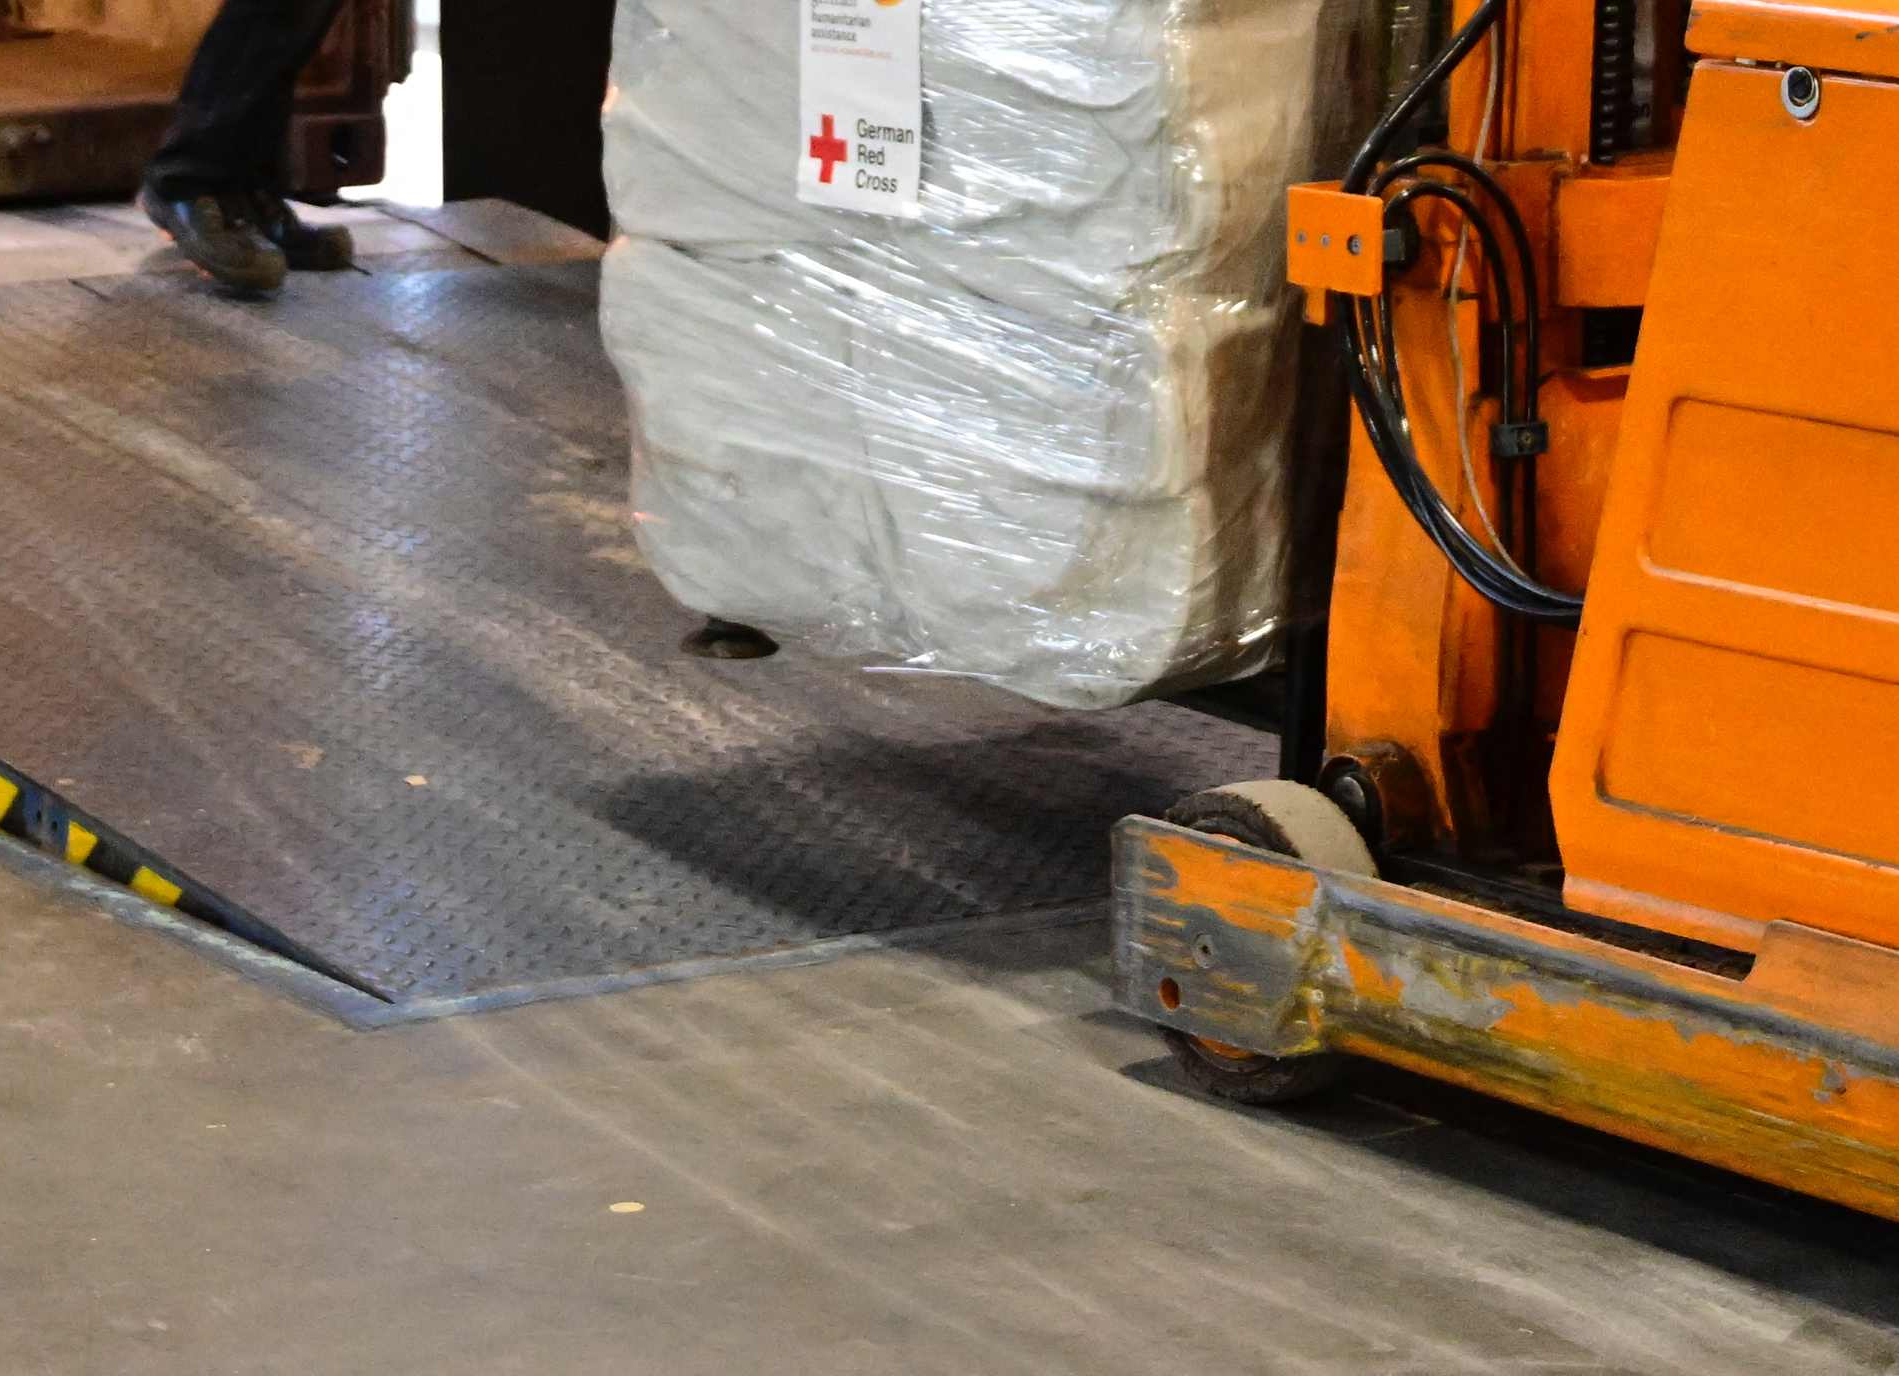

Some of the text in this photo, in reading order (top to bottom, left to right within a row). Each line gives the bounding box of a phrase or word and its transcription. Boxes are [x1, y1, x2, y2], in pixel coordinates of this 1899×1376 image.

[856, 118, 914, 144] German
[857, 144, 885, 166] Red
[855, 169, 898, 193] Cross
